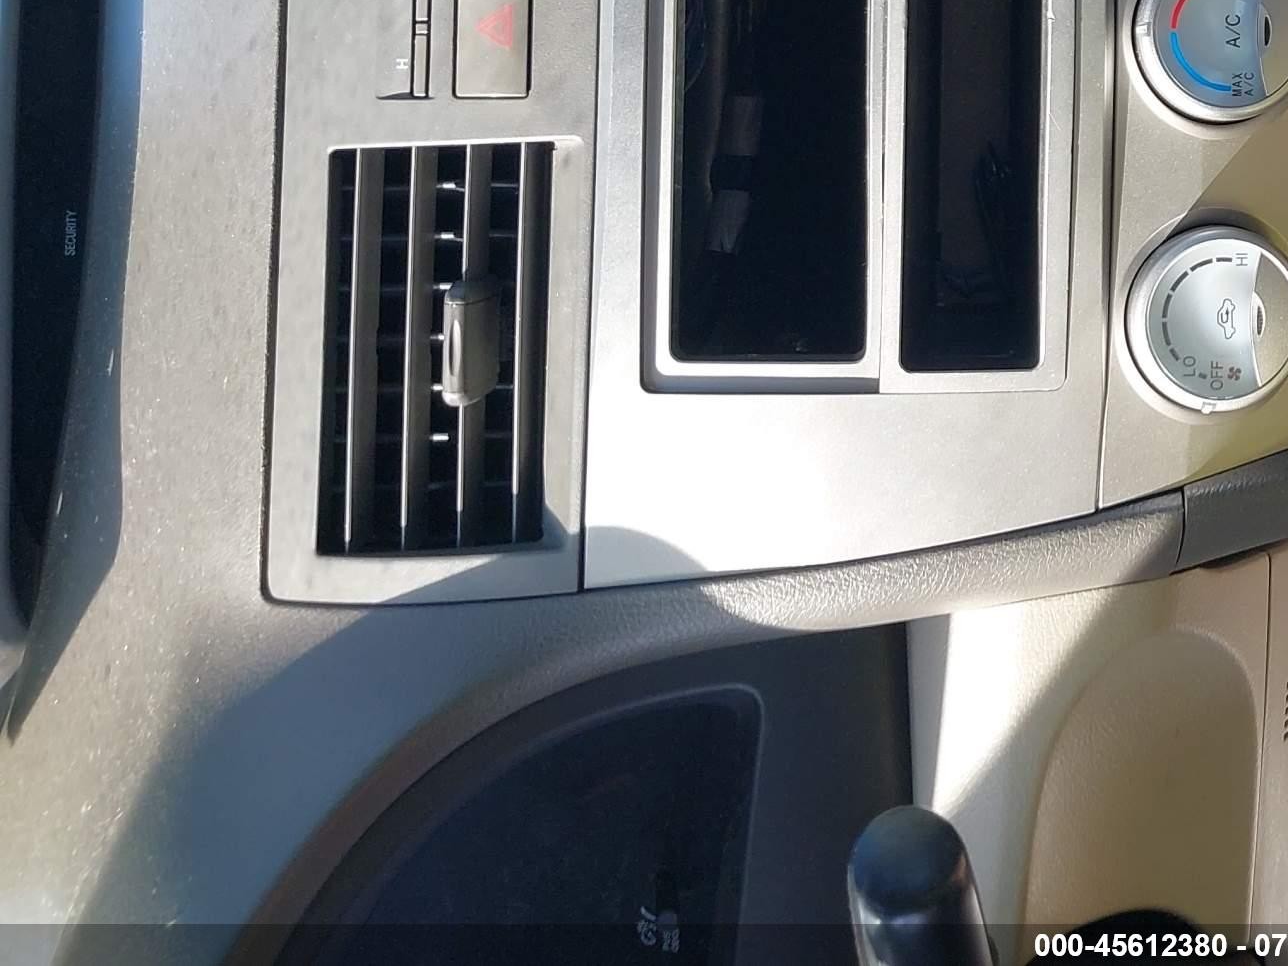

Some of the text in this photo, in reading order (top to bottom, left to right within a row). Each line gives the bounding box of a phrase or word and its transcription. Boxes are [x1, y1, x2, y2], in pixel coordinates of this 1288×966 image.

[1225, 14, 1241, 48] A/C
[395, 58, 409, 69] H
[1231, 72, 1242, 97] MAX
[1243, 72, 1254, 97] A/C
[64, 210, 77, 256] SECURITY
[1236, 252, 1248, 267] HI
[1182, 355, 1197, 377] LO
[1209, 361, 1224, 391] OFF
